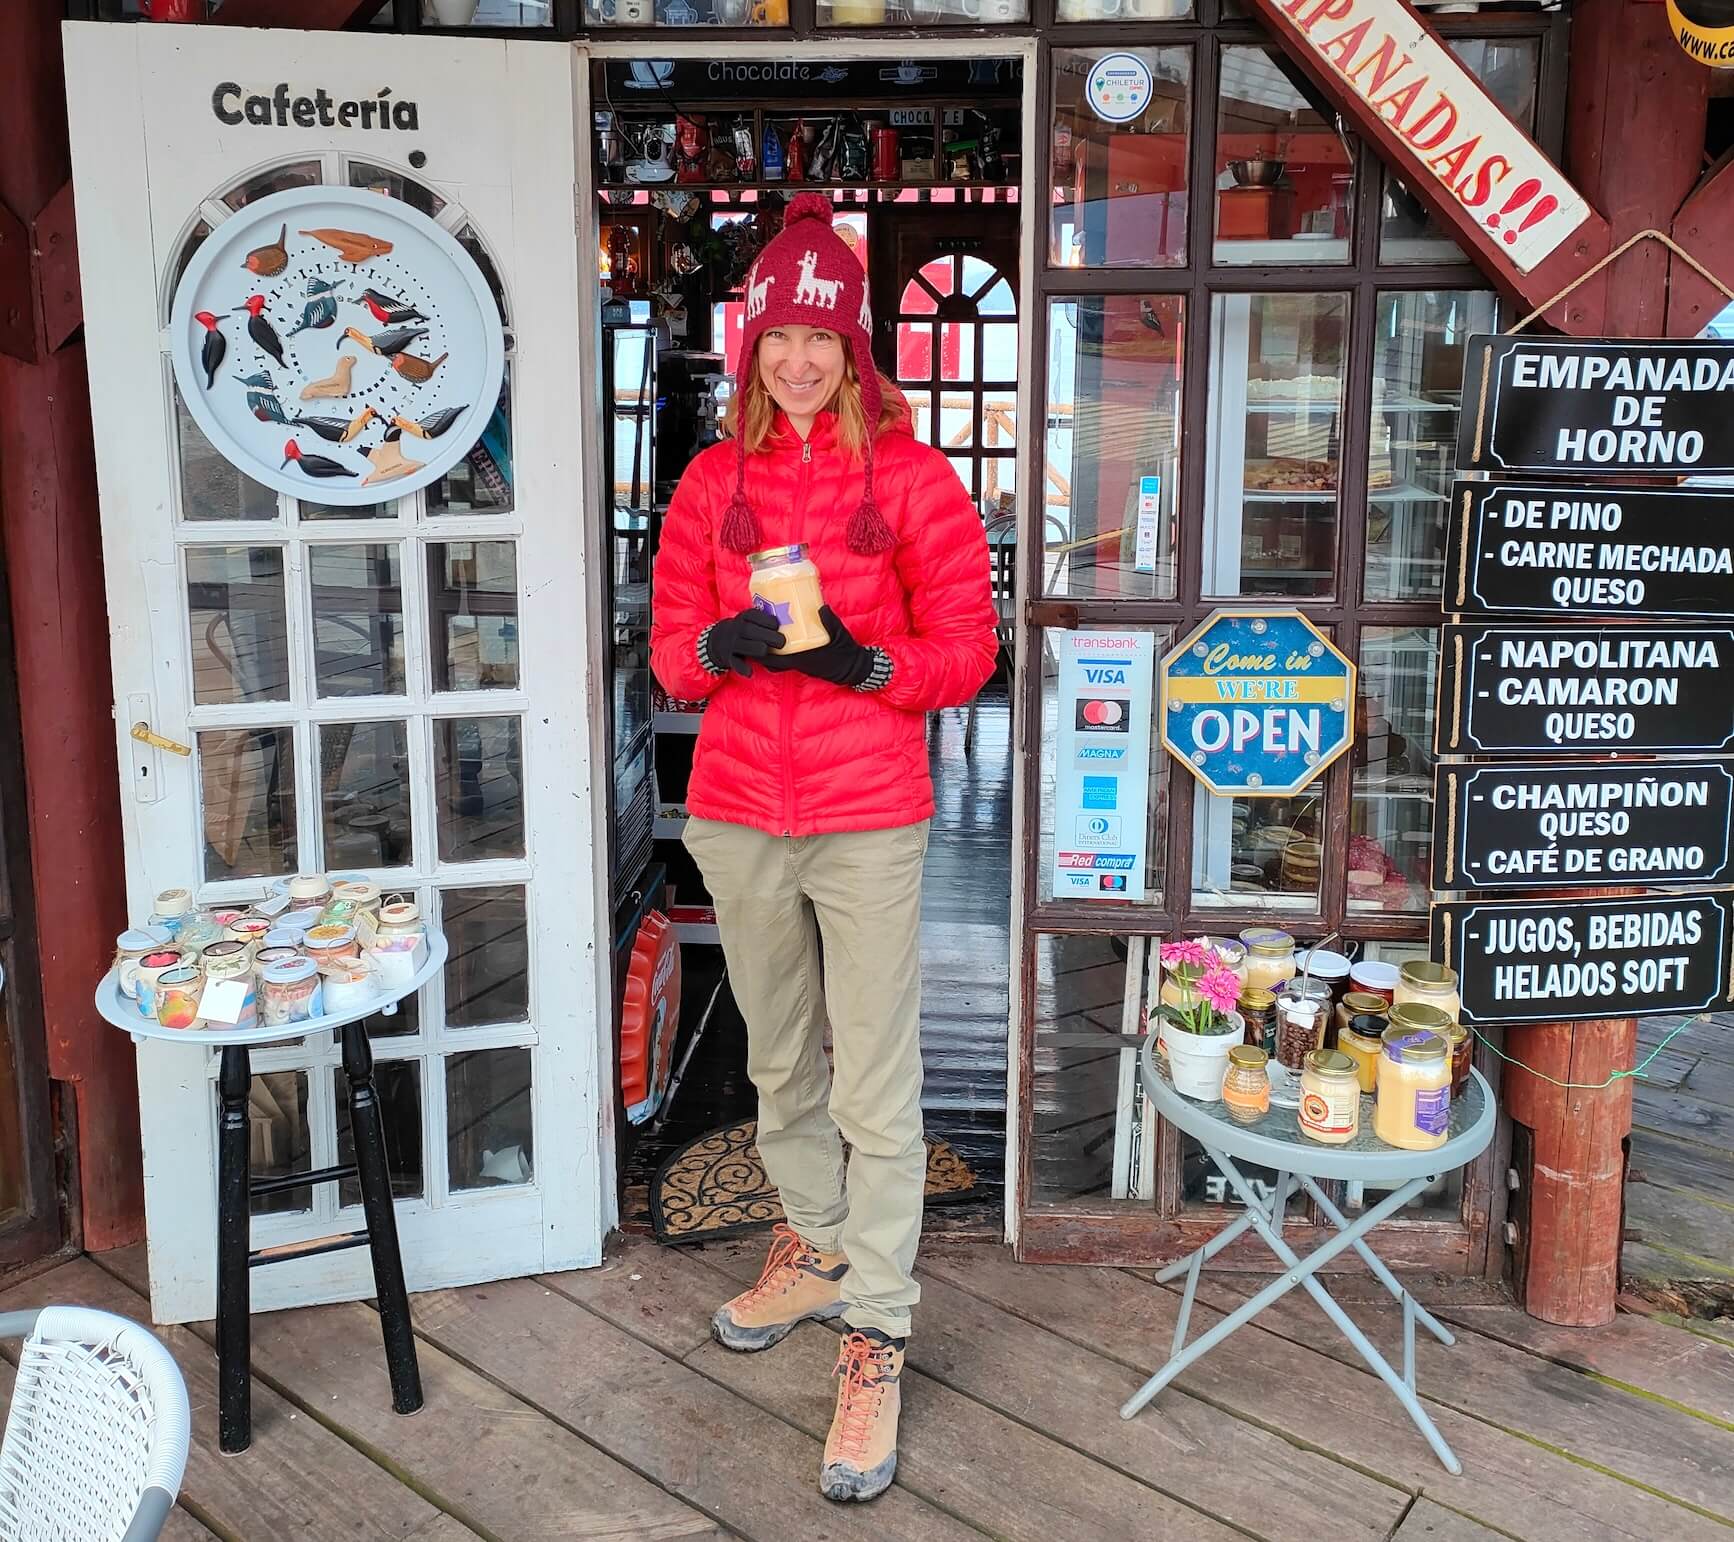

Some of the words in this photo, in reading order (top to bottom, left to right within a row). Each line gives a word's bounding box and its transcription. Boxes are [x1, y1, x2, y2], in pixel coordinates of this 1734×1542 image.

[708, 61, 810, 81] Chocolate
[212, 81, 419, 131] Cafetería
[1511, 354, 1734, 391] EMPANADA
[1611, 395, 1667, 427] DE
[1556, 429, 1705, 464] HORNO
[1504, 500, 1545, 529] DE
[1550, 501, 1623, 532] PINO
[1500, 540, 1594, 570] CARNE
[1599, 543, 1734, 575] MECHADA
[1552, 576, 1646, 607] QUESO
[1072, 636, 1138, 649] transbank
[1500, 640, 1721, 669] NAPOLITANA
[1203, 643, 1277, 675] Come
[1285, 650, 1312, 671] in
[1085, 669, 1125, 684] VISA
[1215, 678, 1299, 700] WE'RE
[1497, 677, 1679, 706] CAMARON
[1191, 708, 1322, 753] OPEN
[1545, 712, 1636, 744] QUESO
[1078, 748, 1119, 758] MAGNA
[1491, 777, 1709, 811] CHAMPIÑON
[1540, 811, 1630, 841] QUESO
[1071, 854, 1094, 866] Red
[1094, 857, 1132, 869] compra
[1487, 842, 1558, 874] CAFÉ
[1564, 849, 1602, 873] DE
[1608, 845, 1704, 872] GRANO
[1070, 877, 1090, 886] VISA
[1484, 916, 1582, 959] JUGOS,
[1588, 909, 1703, 950] BEBIDAS
[1495, 961, 1617, 1001] HELADOS
[1621, 956, 1690, 996] SOFT
